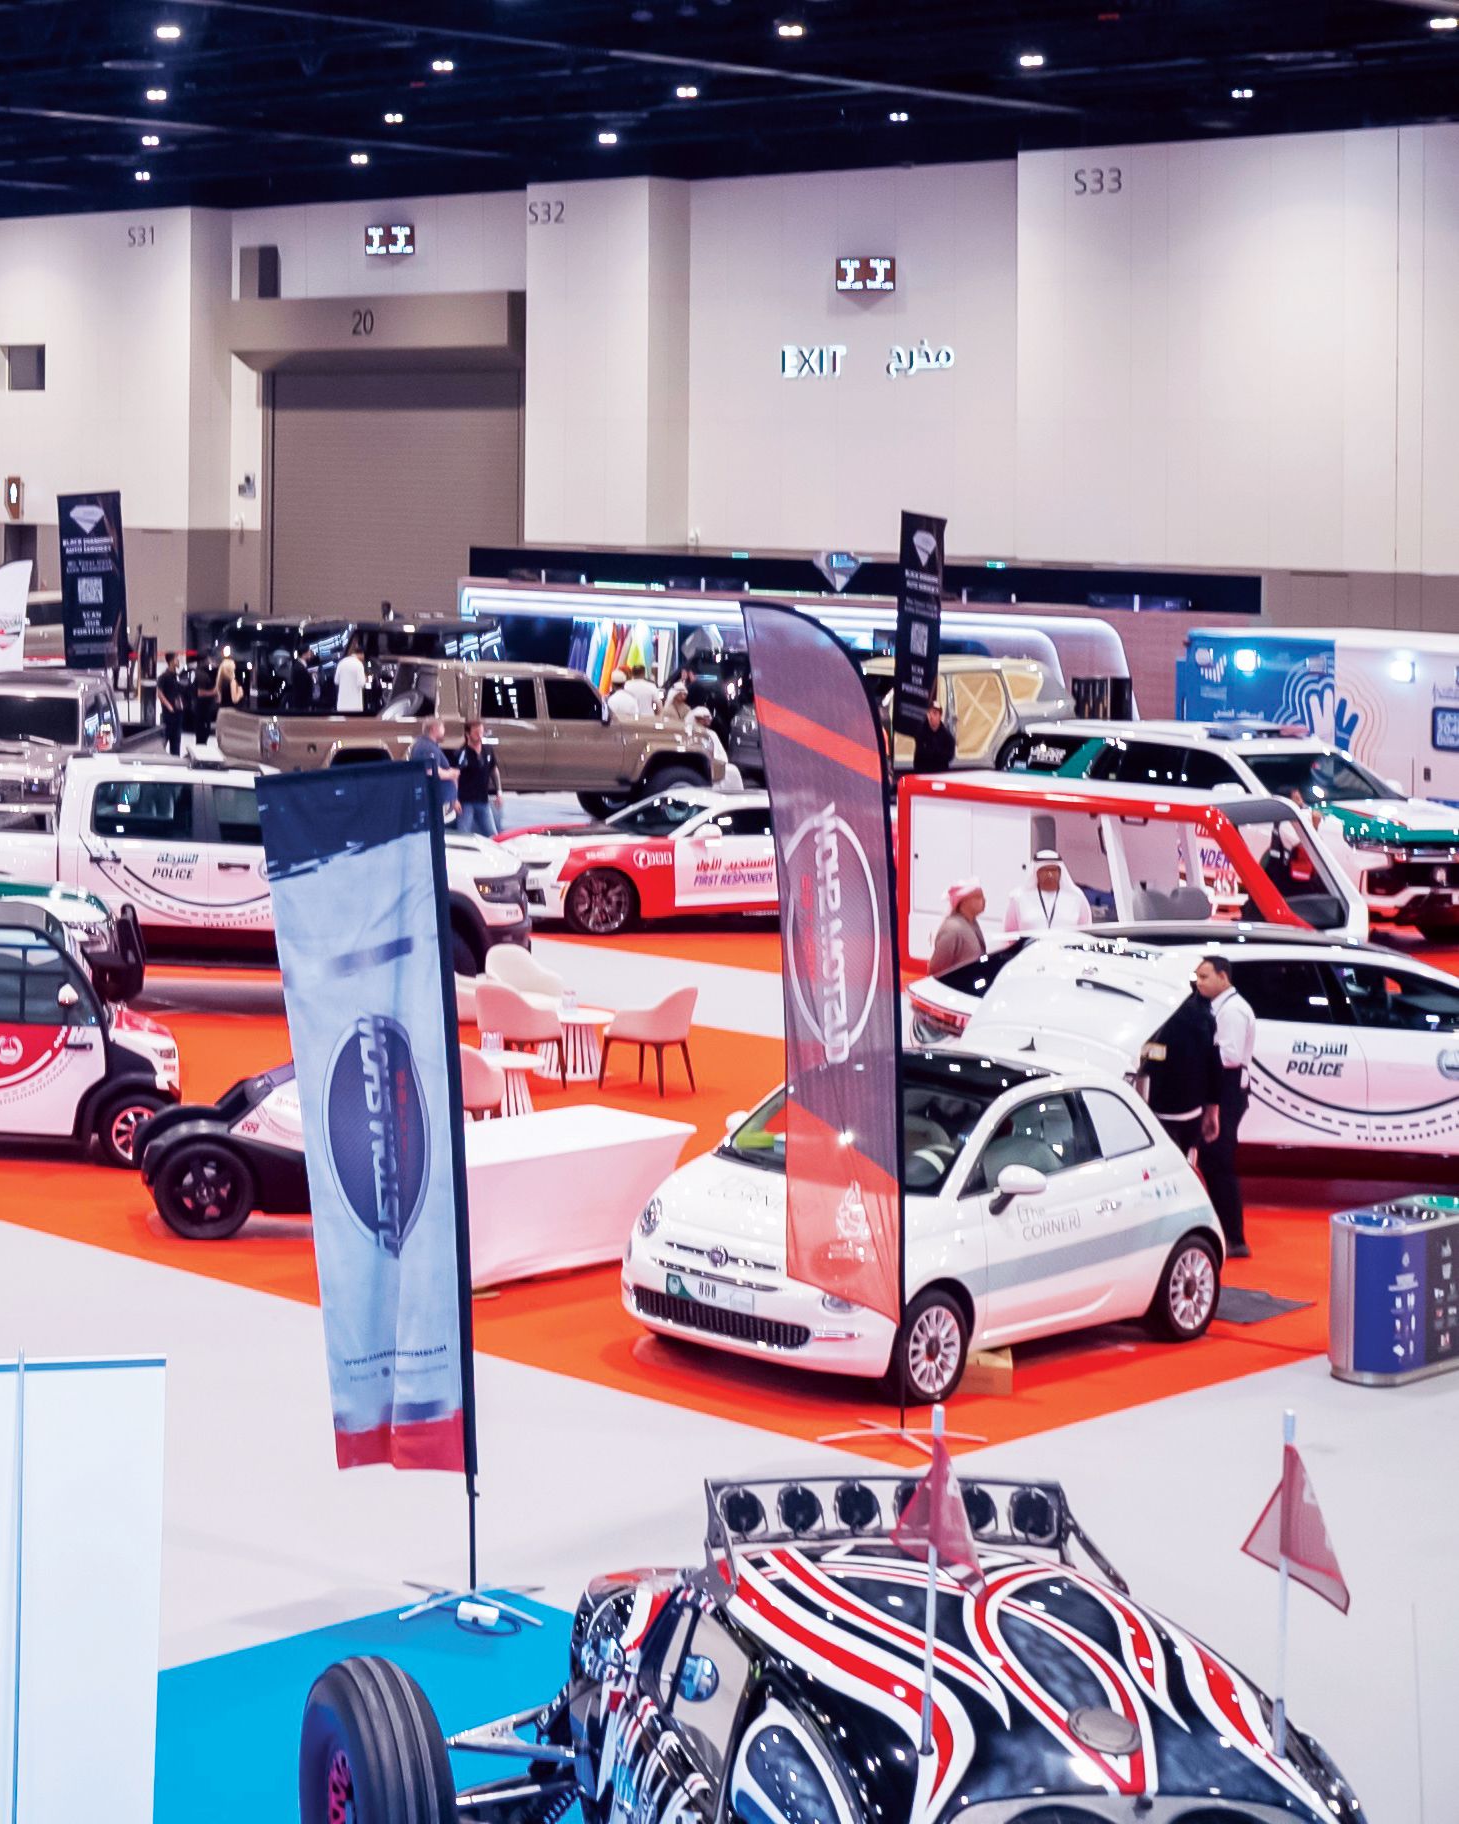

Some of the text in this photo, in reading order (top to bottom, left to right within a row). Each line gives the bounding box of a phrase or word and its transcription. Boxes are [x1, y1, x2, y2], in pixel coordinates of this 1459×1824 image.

[1074, 167, 1123, 195] S33
[528, 201, 565, 224] S32
[127, 225, 156, 248] S31
[351, 309, 374, 335] 20
[781, 345, 847, 378] EXIT
[885, 339, 955, 378] مخرج
[152, 867, 195, 880] POLICE
[694, 872, 773, 887] FIRST RESPONDER
[1292, 1041, 1348, 1060] الشرطة
[1286, 1060, 1344, 1077] POLICE
